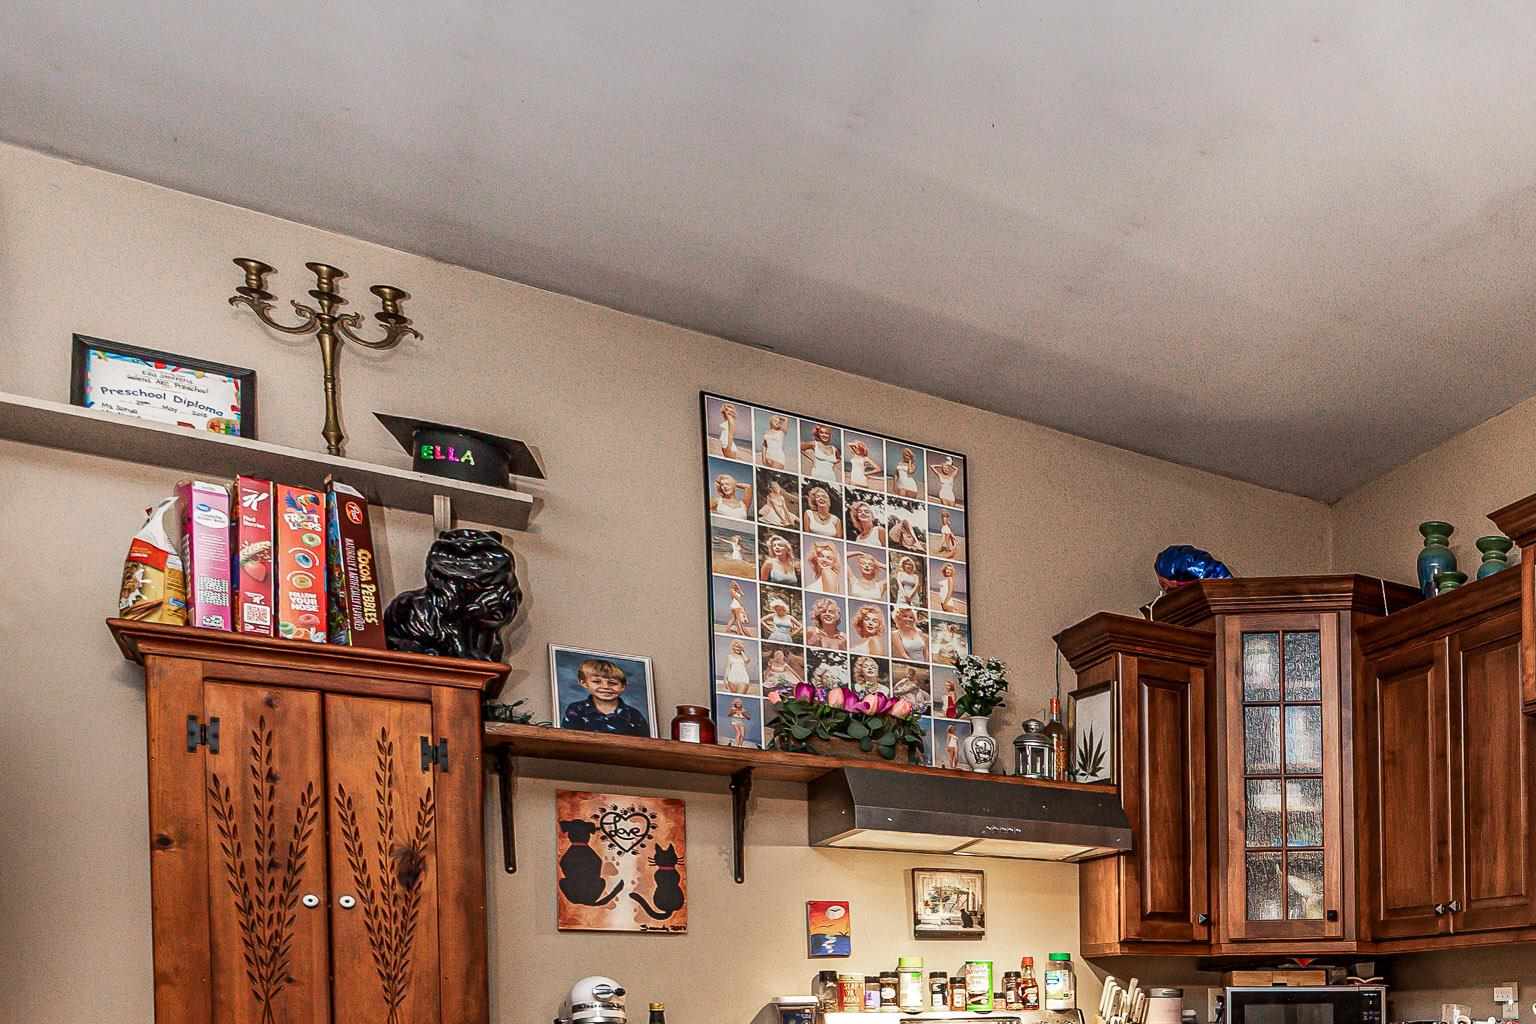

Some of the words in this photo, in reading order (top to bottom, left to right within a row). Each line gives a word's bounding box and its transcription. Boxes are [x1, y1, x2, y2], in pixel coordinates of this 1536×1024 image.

[100, 386, 167, 401] Preschool
[173, 394, 224, 417] Diploma
[420, 444, 475, 466] ELLA
[284, 512, 320, 525] FROOT
[288, 521, 322, 532] LOOPS
[356, 548, 373, 581] COCOA
[361, 580, 378, 625] PEBBLES
